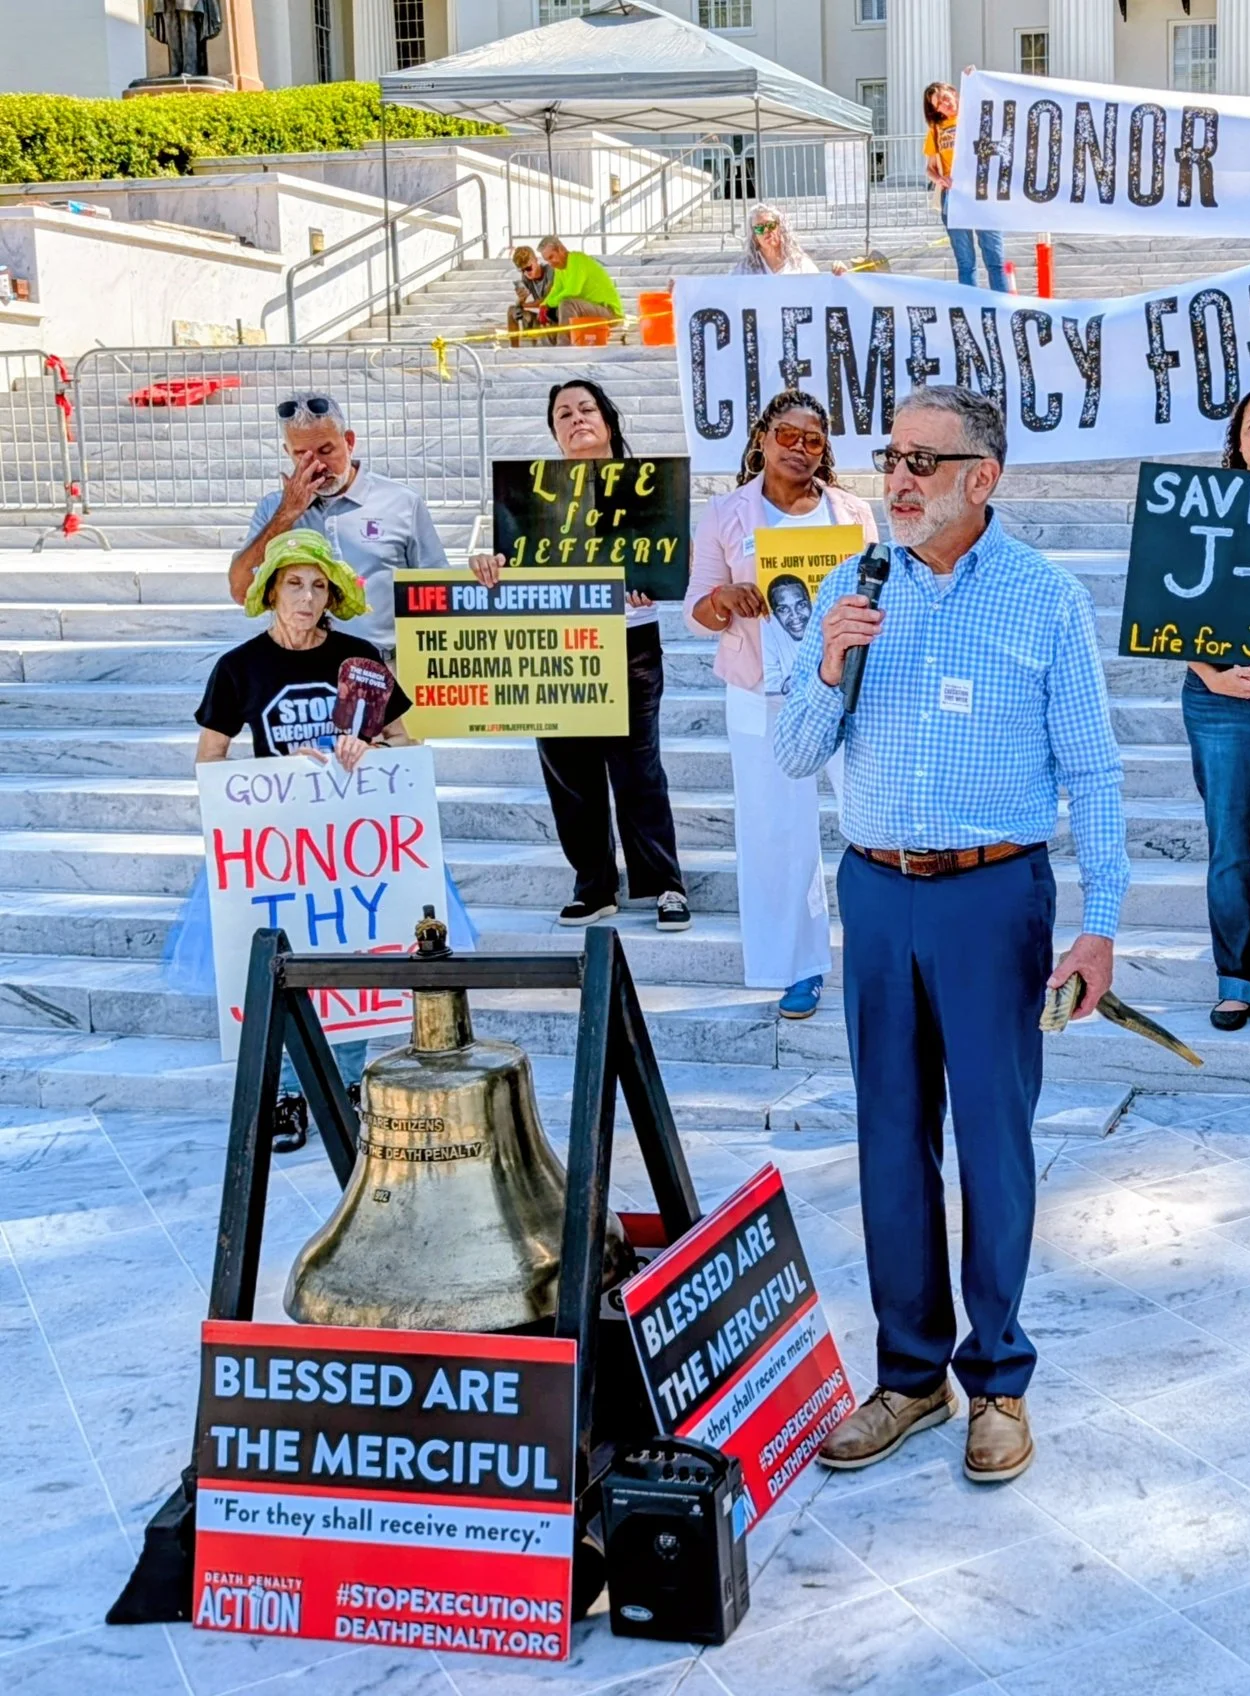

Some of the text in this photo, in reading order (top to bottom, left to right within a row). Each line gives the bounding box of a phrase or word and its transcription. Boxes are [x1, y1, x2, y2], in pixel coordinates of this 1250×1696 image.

[973, 99, 1220, 207] HONOR
[529, 460, 656, 502] LIFE
[560, 501, 626, 534] for
[509, 536, 678, 568] JEFFERY
[760, 557, 778, 569] THE
[781, 556, 804, 568] JURY
[808, 554, 837, 567] VOTED
[407, 584, 612, 611] LIFE FOR JEFFERY LEE
[416, 628, 604, 651] THE JURY VOTED LIFE.
[1130, 623, 1182, 653] Life
[1194, 626, 1232, 655] for
[427, 656, 601, 679] ALABAMA PLANS TO
[415, 683, 615, 706] EXECUTE HIM ANYWAY.
[305, 763, 415, 804] IVEY:
[213, 815, 429, 890] HONOR
[251, 882, 388, 947] THY
[391, 1119, 443, 1132] CITIZENS
[385, 1147, 421, 1160] DEATH
[425, 1143, 481, 1160] PENALTY
[640, 1252, 734, 1358] BLESSED
[736, 1213, 776, 1275] ARE
[658, 1349, 710, 1422] THE
[709, 1260, 808, 1382] MERCIFUL
[214, 1355, 519, 1414] BLESSED ARE
[708, 1410, 731, 1446] they
[733, 1384, 755, 1422] shall
[755, 1356, 786, 1396] receive
[759, 1368, 844, 1471] #STOPEXECUTIONS
[210, 1426, 558, 1491] THE MERCIFUL
[767, 1393, 852, 1498] DEATHPENALTY.ORG
[214, 1498, 551, 1553] "For they shall receive mercy."
[204, 1572, 302, 1589] DEATH PENALTY
[196, 1585, 301, 1633] ACTION
[335, 1583, 563, 1624] #STOPEXECUTIONS
[334, 1619, 560, 1656] DEATHPENALTY.ORG
